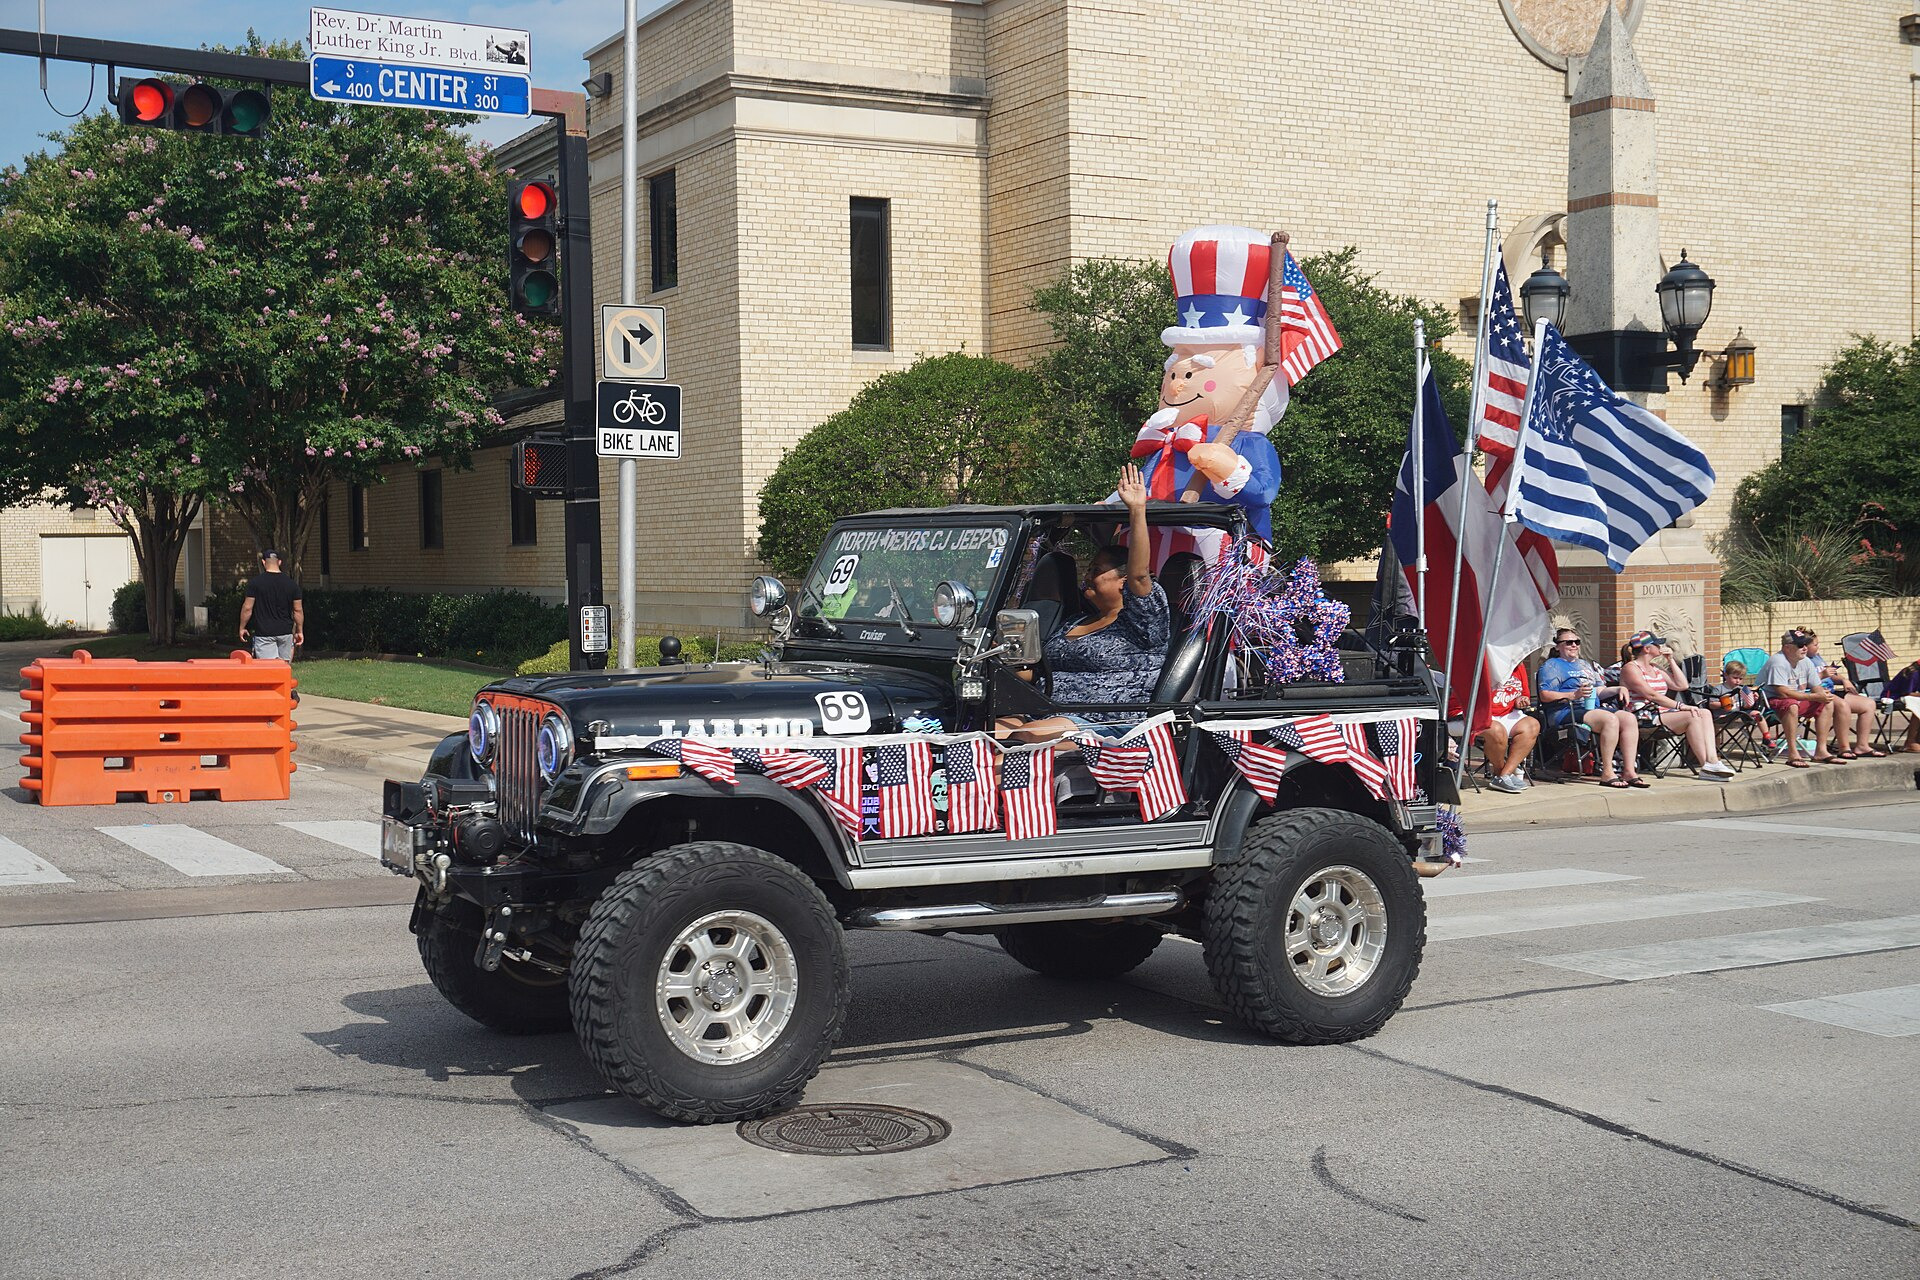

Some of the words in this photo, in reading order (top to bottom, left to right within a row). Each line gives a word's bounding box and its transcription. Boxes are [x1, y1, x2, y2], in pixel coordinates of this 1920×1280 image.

[316, 12, 350, 30] Rev.
[357, 17, 382, 34] Dr.
[388, 20, 442, 40] Martin
[316, 31, 371, 50] Luther
[378, 37, 415, 58] King
[419, 41, 441, 57] Jr.
[449, 47, 482, 61] Blvd.
[346, 63, 355, 78] S
[378, 69, 468, 105] CENTER
[484, 76, 499, 91] ST
[346, 82, 373, 99] 400
[474, 94, 499, 110] 300
[603, 433, 634, 451] BIKE
[640, 434, 675, 452] LANE
[836, 531, 882, 551] NORTH
[887, 529, 931, 551] TEXAS
[930, 530, 950, 550] CJ
[951, 528, 1003, 550] JEEPS
[829, 558, 856, 584] 69
[1642, 583, 1697, 596] DOWNTOWN
[859, 629, 887, 641] Cruiser
[820, 694, 865, 722] 69
